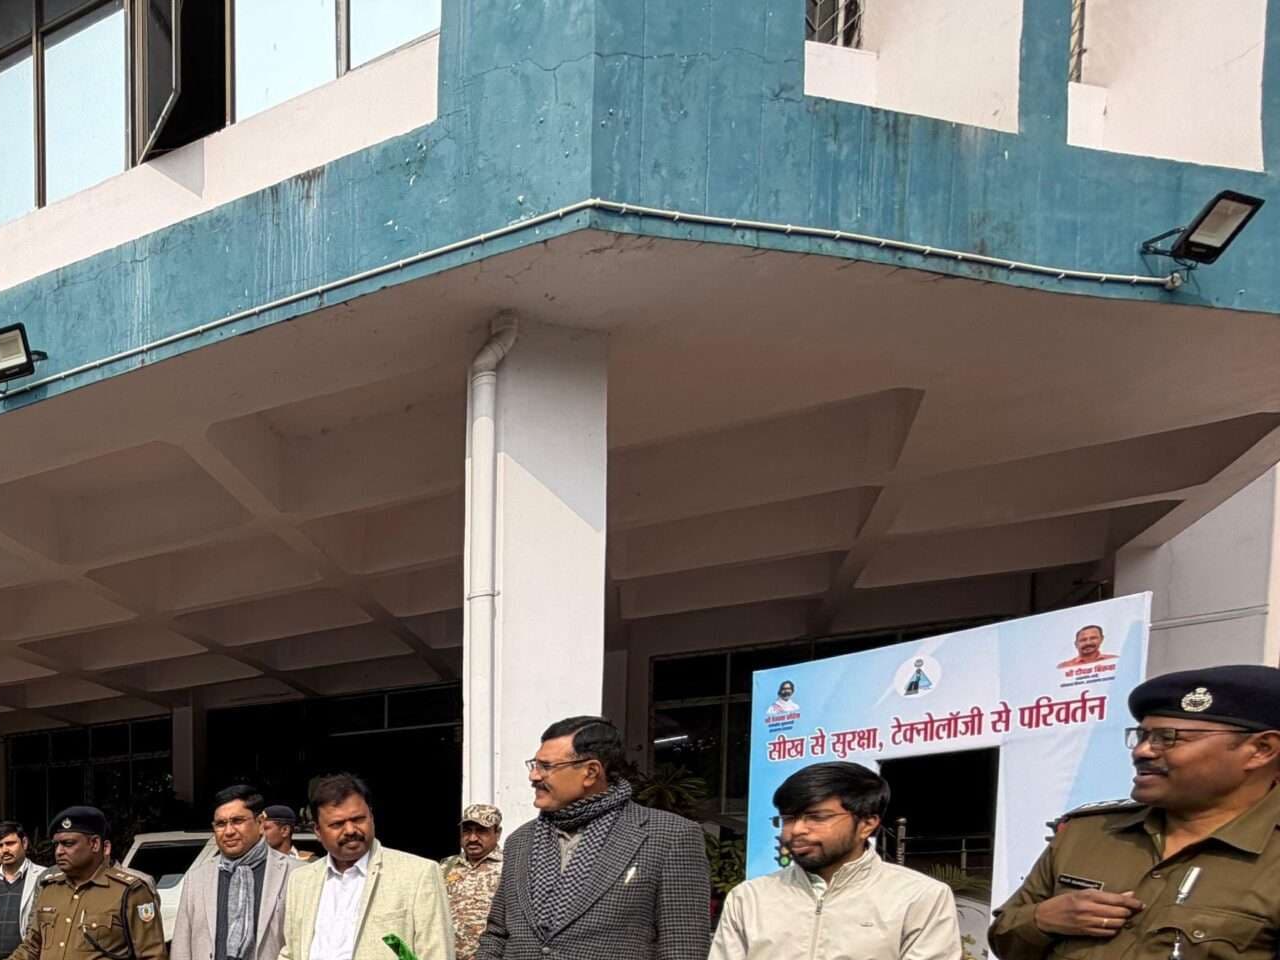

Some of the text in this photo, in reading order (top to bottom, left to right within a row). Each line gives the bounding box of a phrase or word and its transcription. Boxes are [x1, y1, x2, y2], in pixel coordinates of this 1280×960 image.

[768, 690, 1107, 760] सीख से सुरक्षा, टेक्नोलॉजी से परिवर्तन
